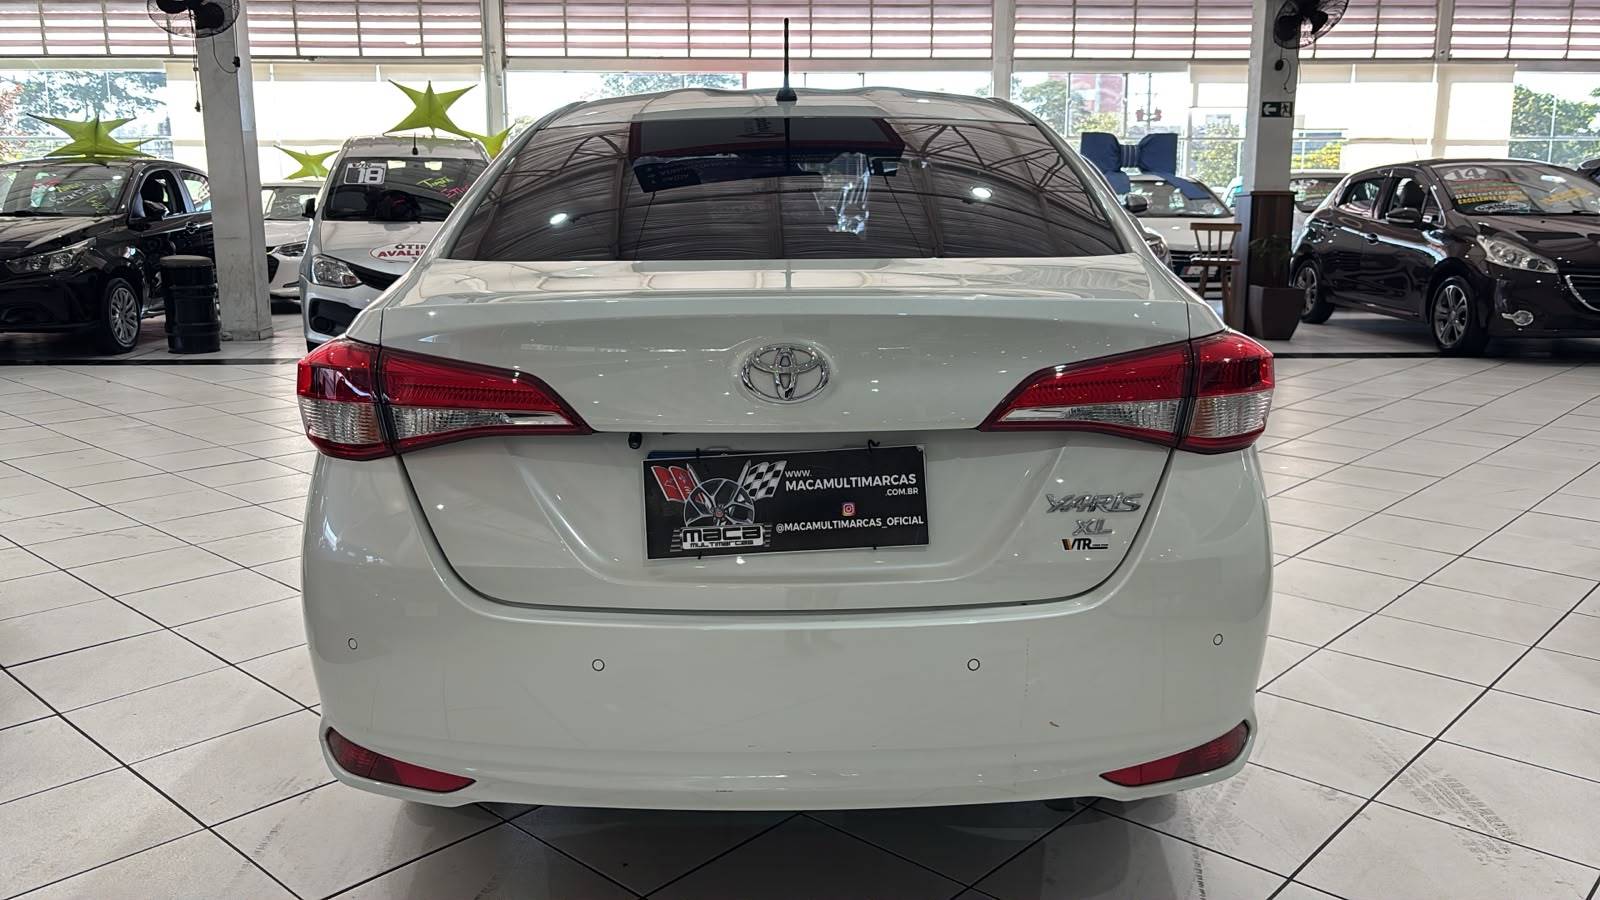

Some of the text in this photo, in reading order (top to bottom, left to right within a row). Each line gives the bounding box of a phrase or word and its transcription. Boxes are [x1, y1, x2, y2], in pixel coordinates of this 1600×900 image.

[358, 168, 384, 184] 18
[1453, 168, 1481, 179] 14
[785, 473, 917, 491] MACAMULTIMARCAS
[885, 487, 919, 496] .COM.BR
[1046, 493, 1144, 513] YARIS
[776, 515, 924, 534] @MACAMULTIMARCAS_OFICIAL
[1072, 519, 1113, 536] XL
